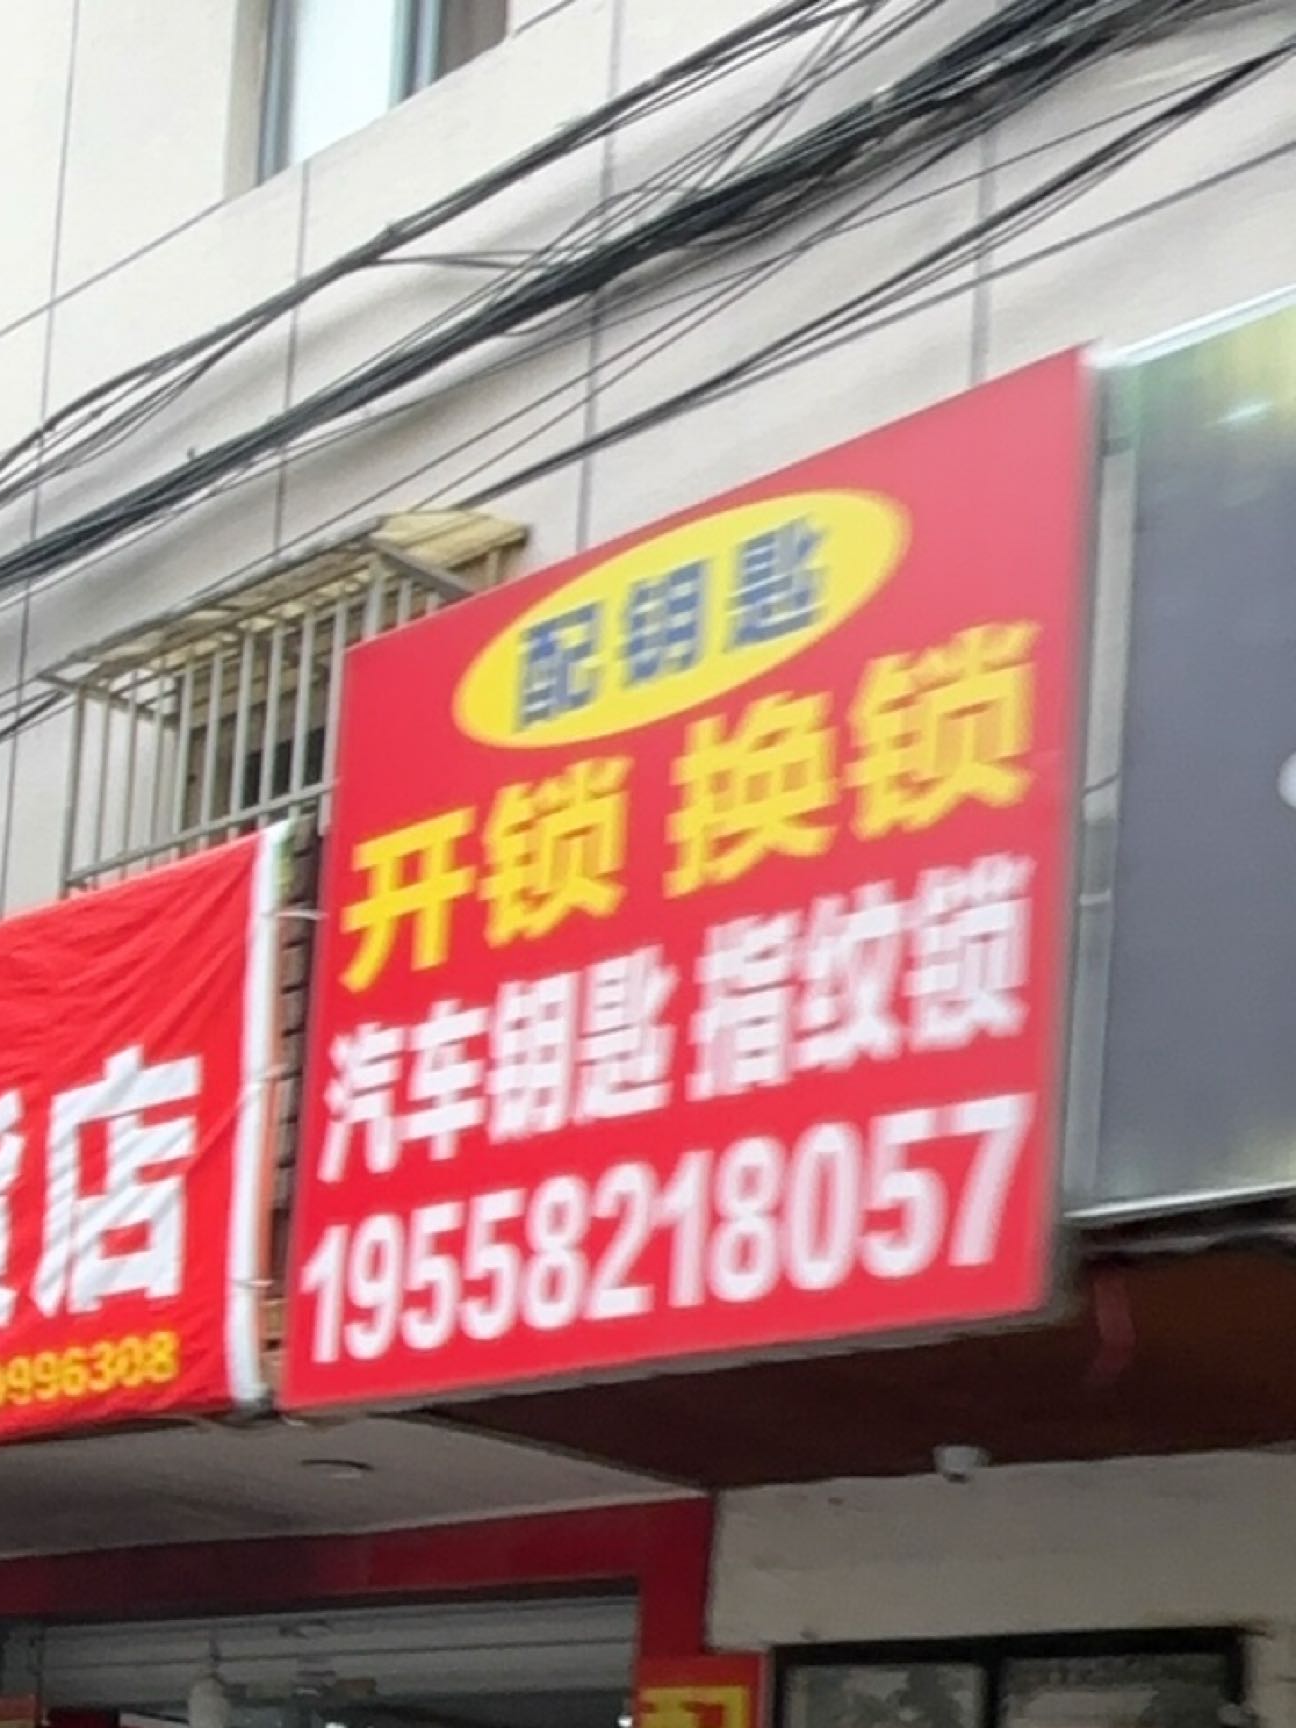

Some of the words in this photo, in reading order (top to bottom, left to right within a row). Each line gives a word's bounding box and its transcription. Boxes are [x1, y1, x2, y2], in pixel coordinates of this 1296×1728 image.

[512, 516, 834, 731] 配钥匙
[340, 754, 632, 993] 开锁
[665, 619, 1041, 897] 换锁
[317, 941, 682, 1184] 汽车钥匙
[686, 853, 1033, 1100] 指纹锁
[302, 1092, 1033, 1367] 19558218057
